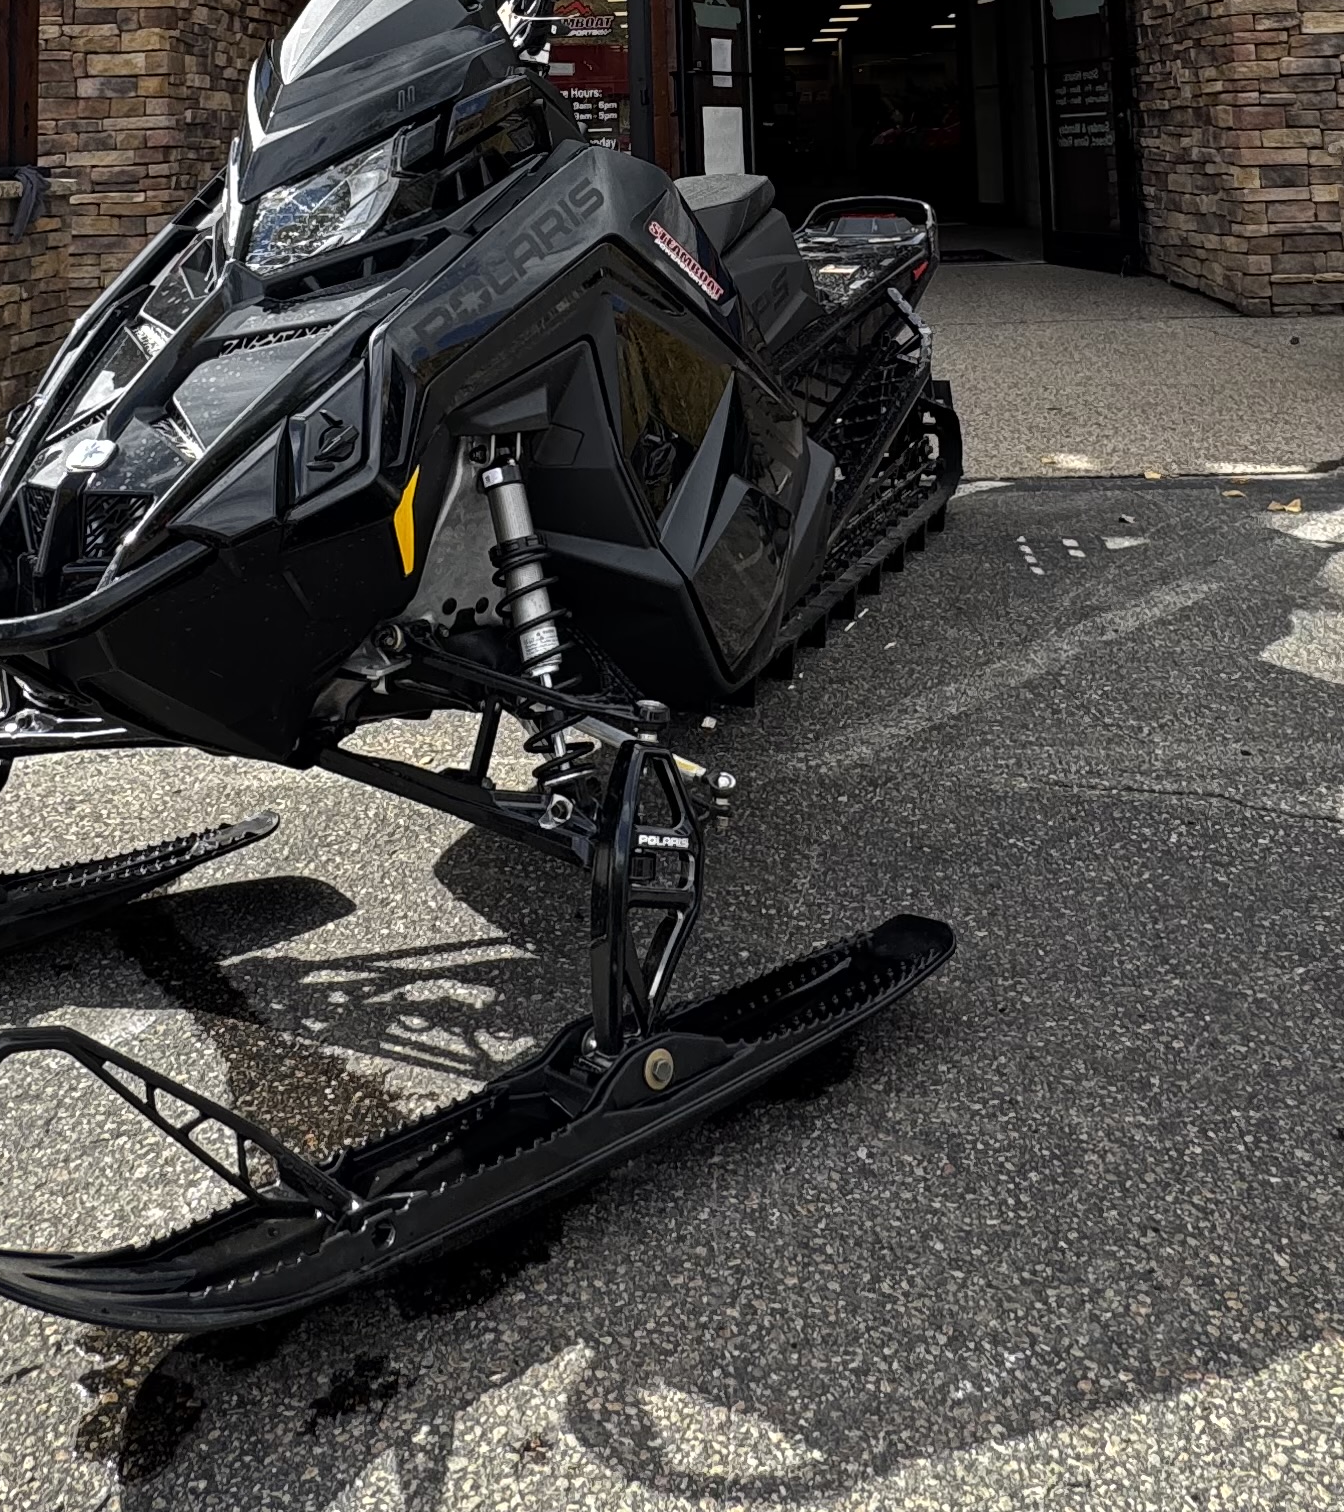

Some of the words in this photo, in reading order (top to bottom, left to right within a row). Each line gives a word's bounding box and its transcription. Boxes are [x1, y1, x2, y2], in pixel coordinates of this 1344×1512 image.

[561, 15, 615, 29] MBOAT
[570, 87, 603, 99] Hours:
[412, 177, 606, 341] POLARIS
[649, 221, 725, 304] STEAMBOAT
[638, 834, 690, 849] POLARIS
